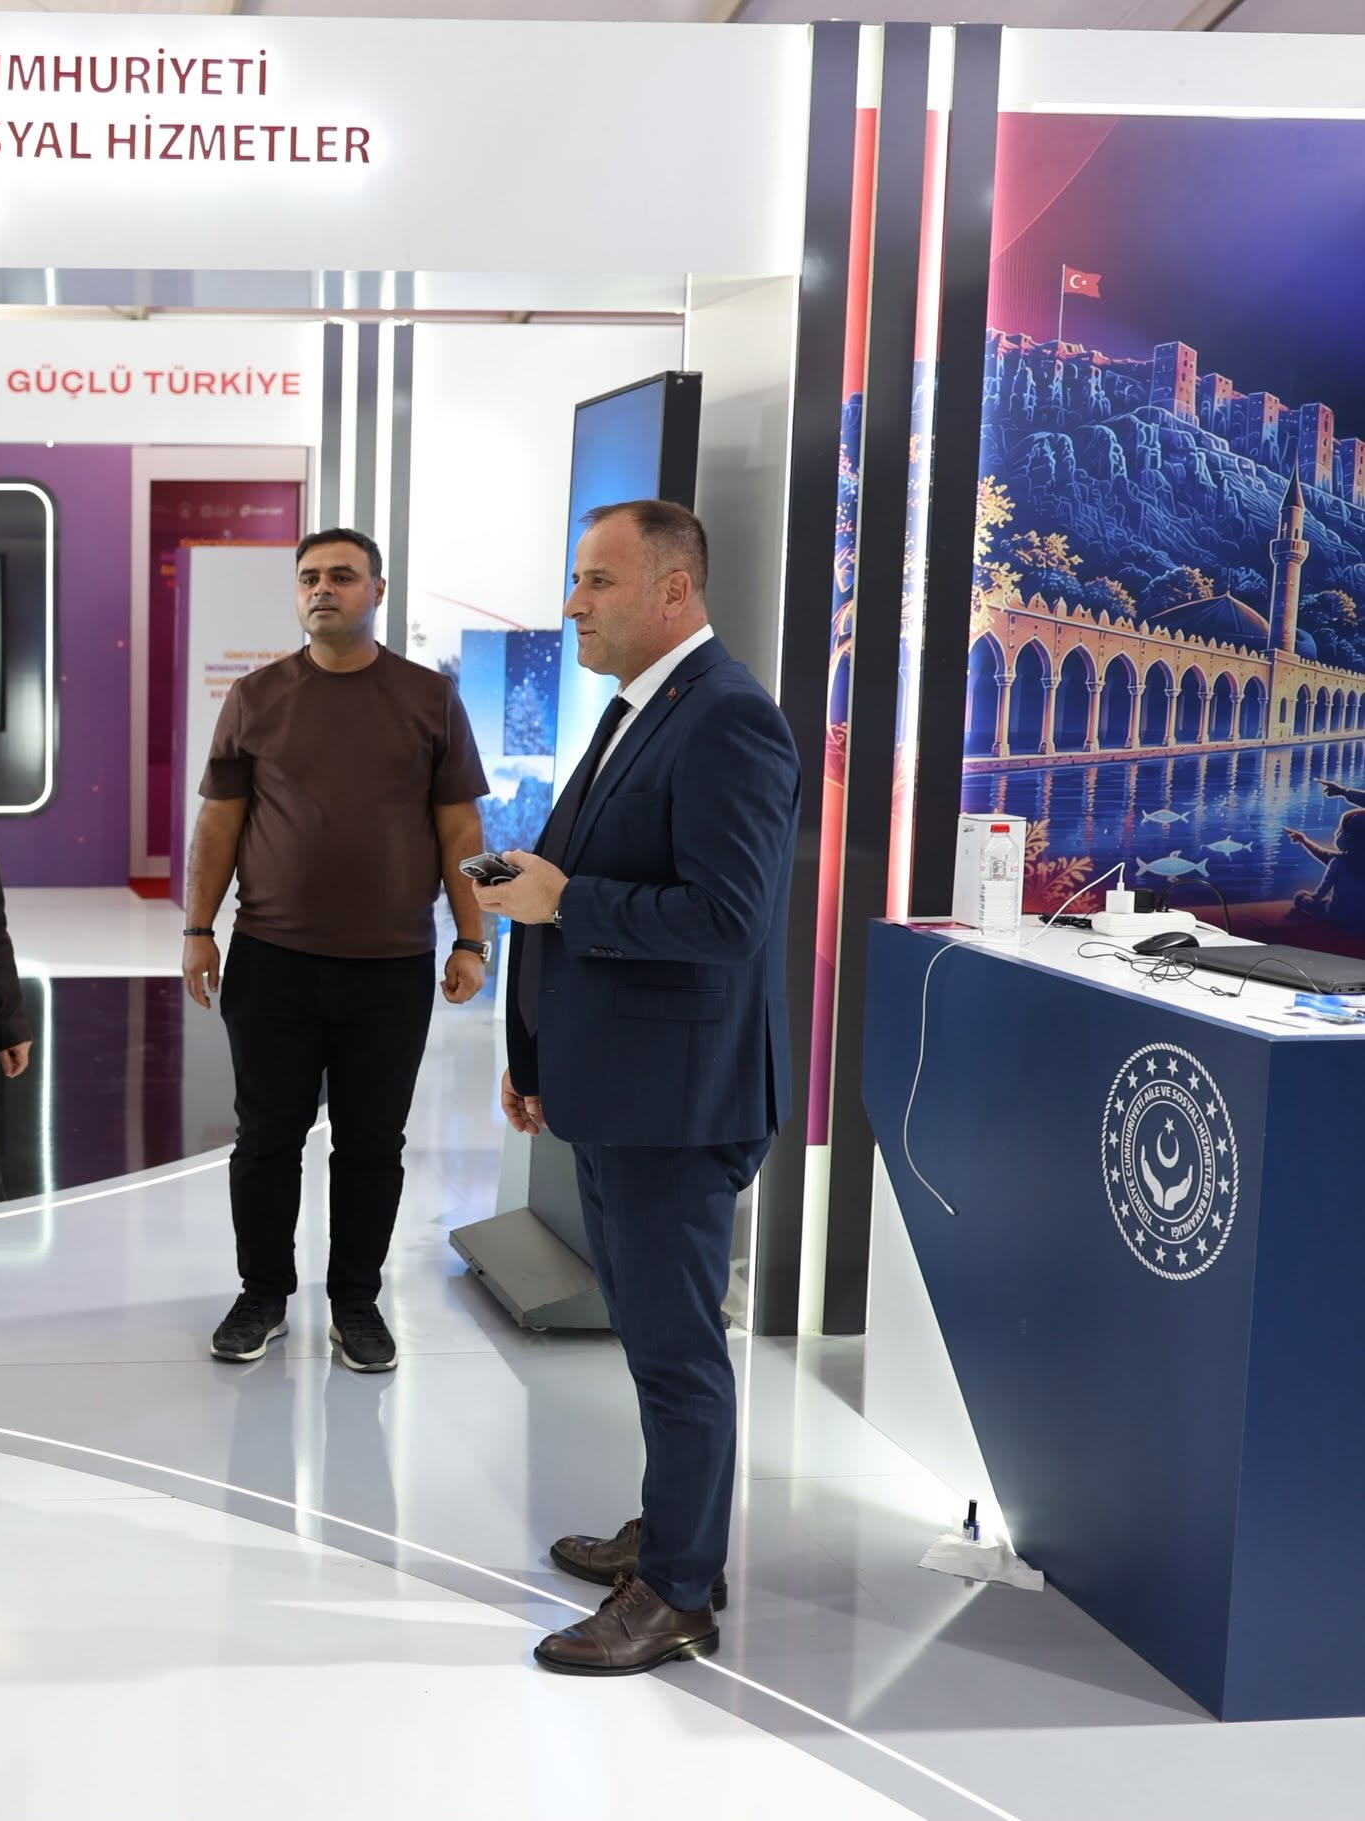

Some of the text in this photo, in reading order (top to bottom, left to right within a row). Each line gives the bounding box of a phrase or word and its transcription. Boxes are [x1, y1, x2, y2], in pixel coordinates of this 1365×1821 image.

[107, 114, 370, 163] HİZMETLER
[7, 364, 132, 399] GÜÇLÜ
[143, 365, 301, 395] TÜRKİYE
[1144, 1086, 1161, 1103] AİLE
[1160, 1085, 1172, 1098] VE
[1172, 1089, 1198, 1125] SOSYAL
